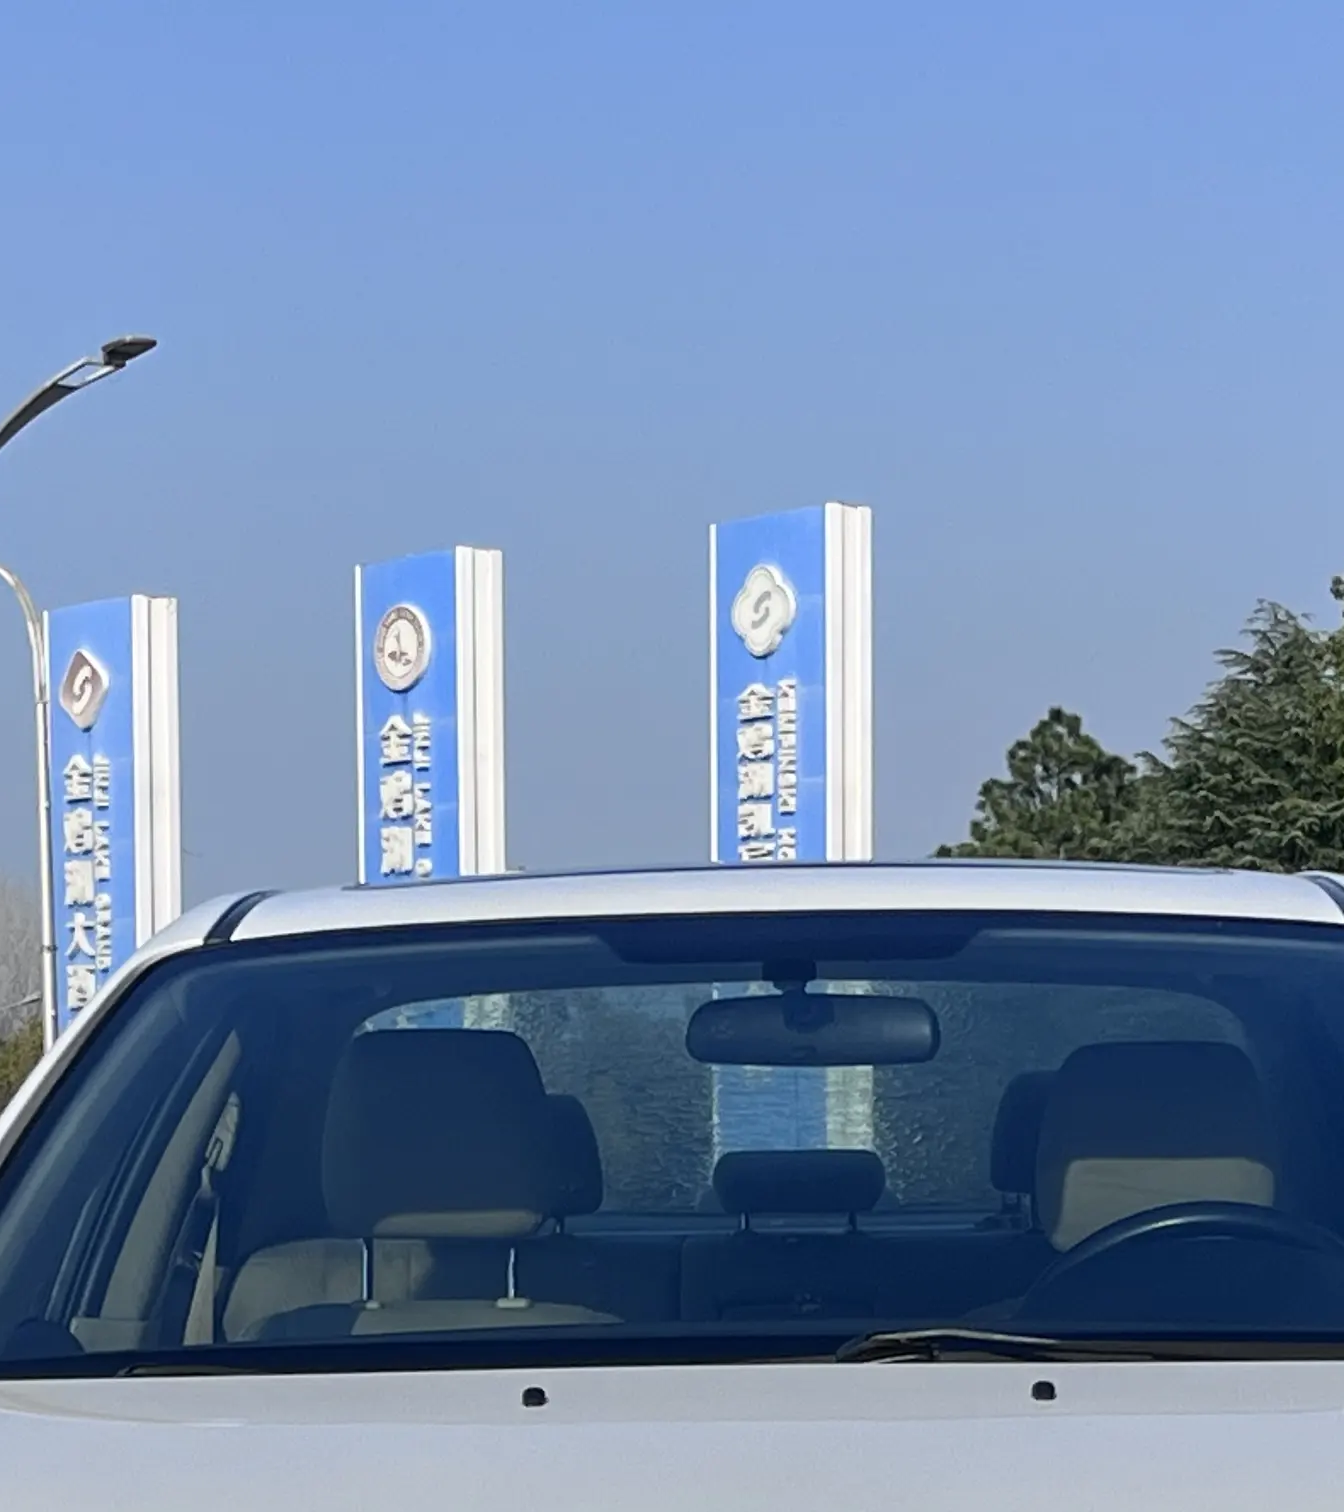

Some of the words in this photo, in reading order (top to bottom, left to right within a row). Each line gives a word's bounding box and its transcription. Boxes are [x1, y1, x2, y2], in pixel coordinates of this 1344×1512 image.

[413, 711, 431, 767] JINJI
[777, 678, 797, 813] KEMPINSKI
[93, 752, 110, 807] JINJI
[415, 782, 432, 845] LAKE
[94, 820, 111, 880] LAKE
[63, 754, 96, 1028] 金鸡湖大酒
[95, 893, 112, 970] GRAND
